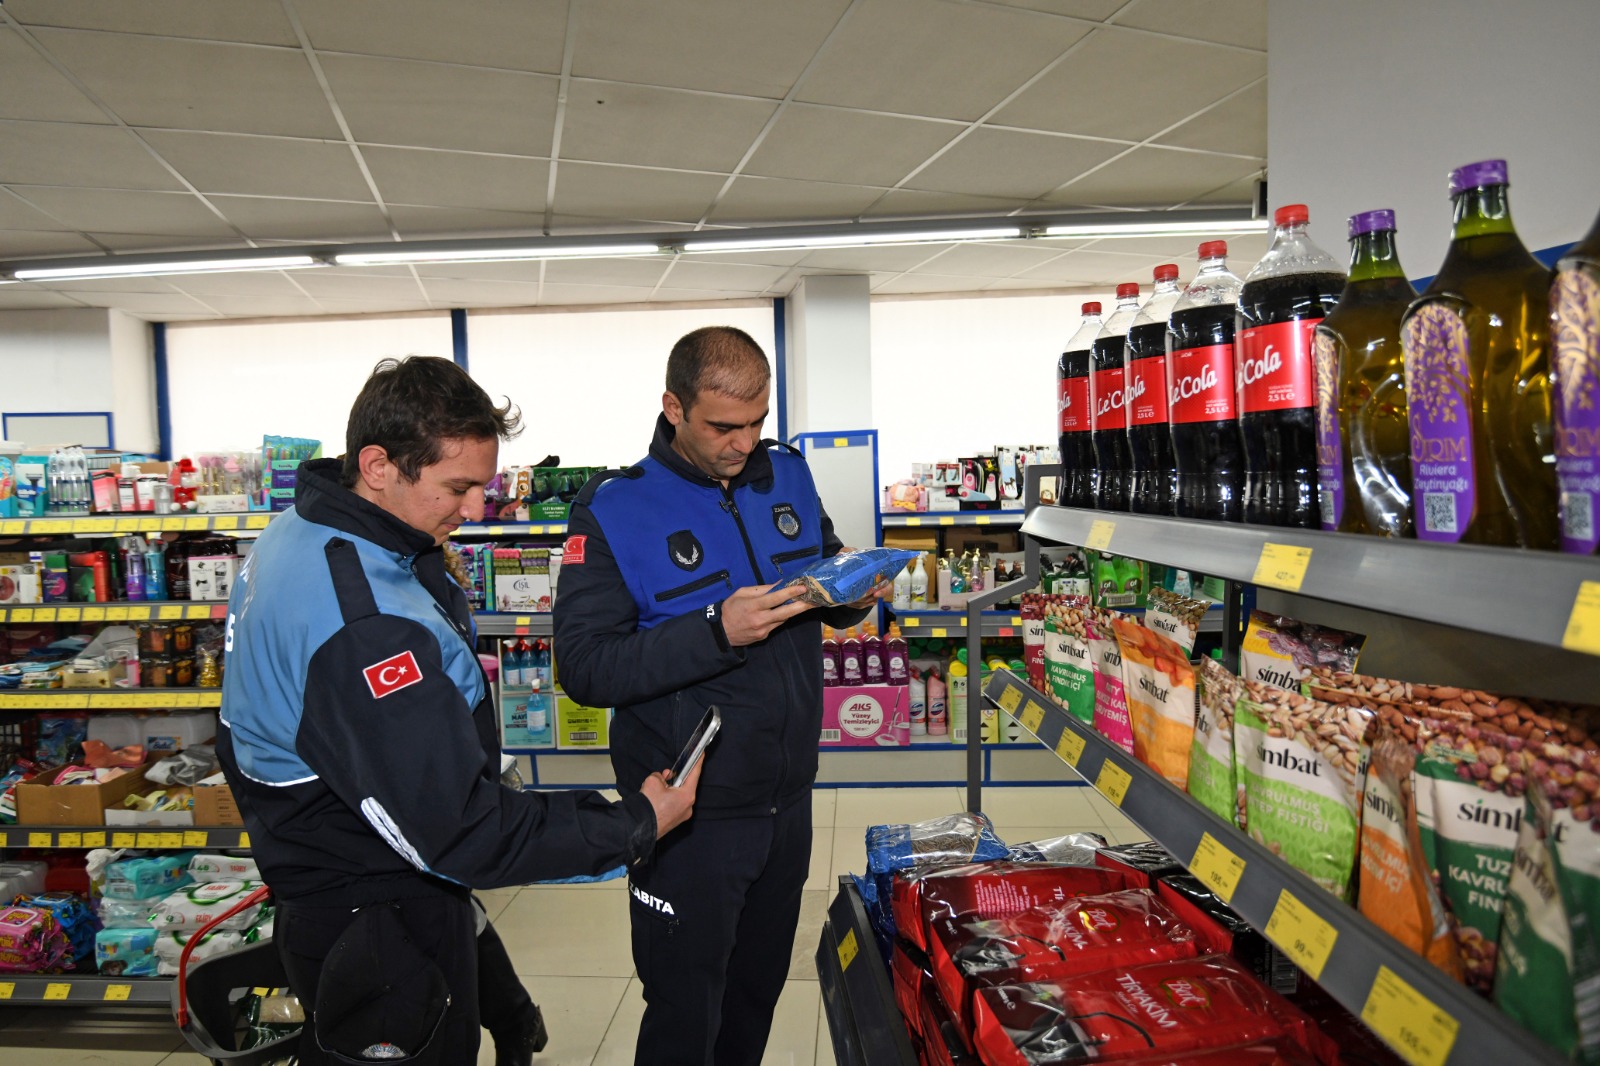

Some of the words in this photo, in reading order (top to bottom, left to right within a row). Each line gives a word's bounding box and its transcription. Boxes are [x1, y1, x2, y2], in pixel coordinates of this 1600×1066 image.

[1057, 641, 1087, 660] simbat
[849, 703, 872, 712] AKS
[1115, 972, 1178, 1029] TİRYAKİM
